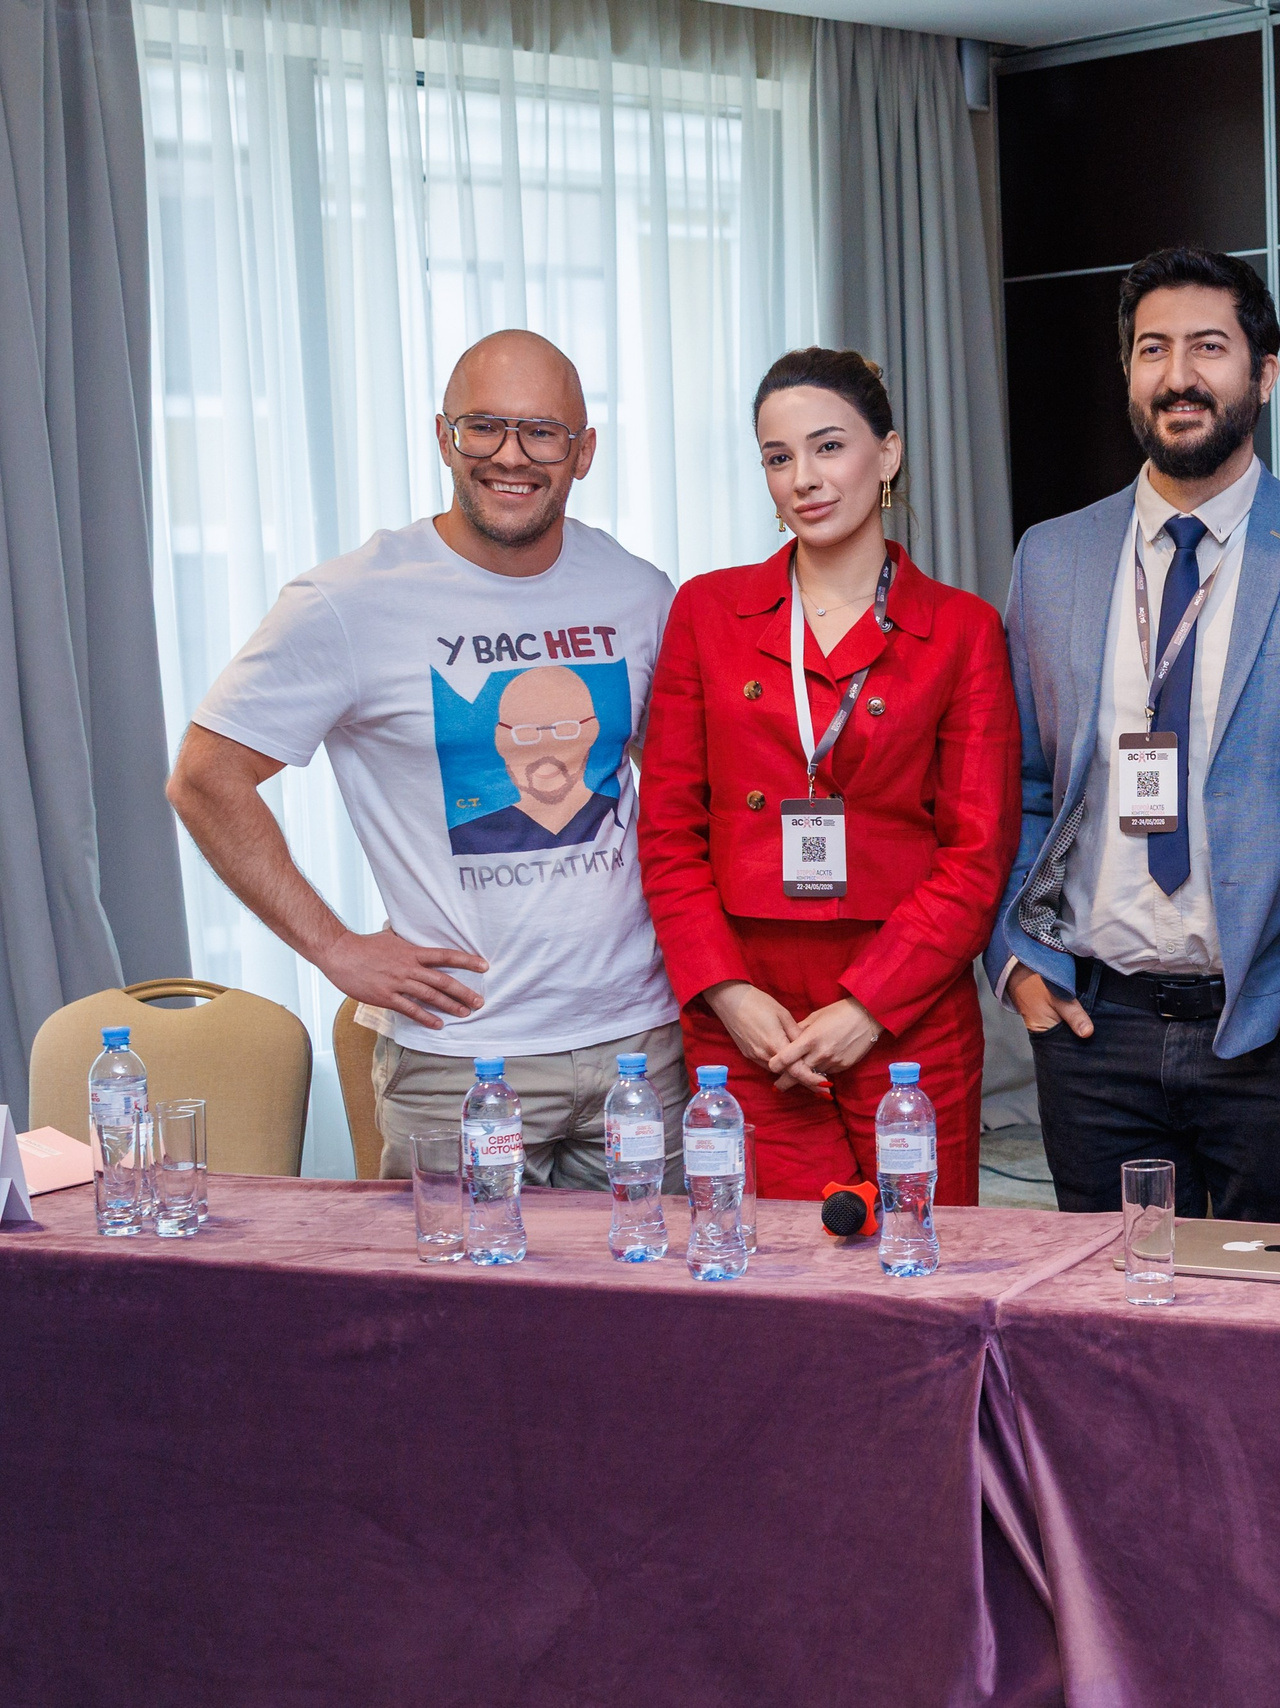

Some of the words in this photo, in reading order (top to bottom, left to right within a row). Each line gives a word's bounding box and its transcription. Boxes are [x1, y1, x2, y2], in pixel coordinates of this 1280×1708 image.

[437, 635, 465, 666] У
[472, 632, 541, 664] ВАС
[544, 626, 616, 659] НЕТ
